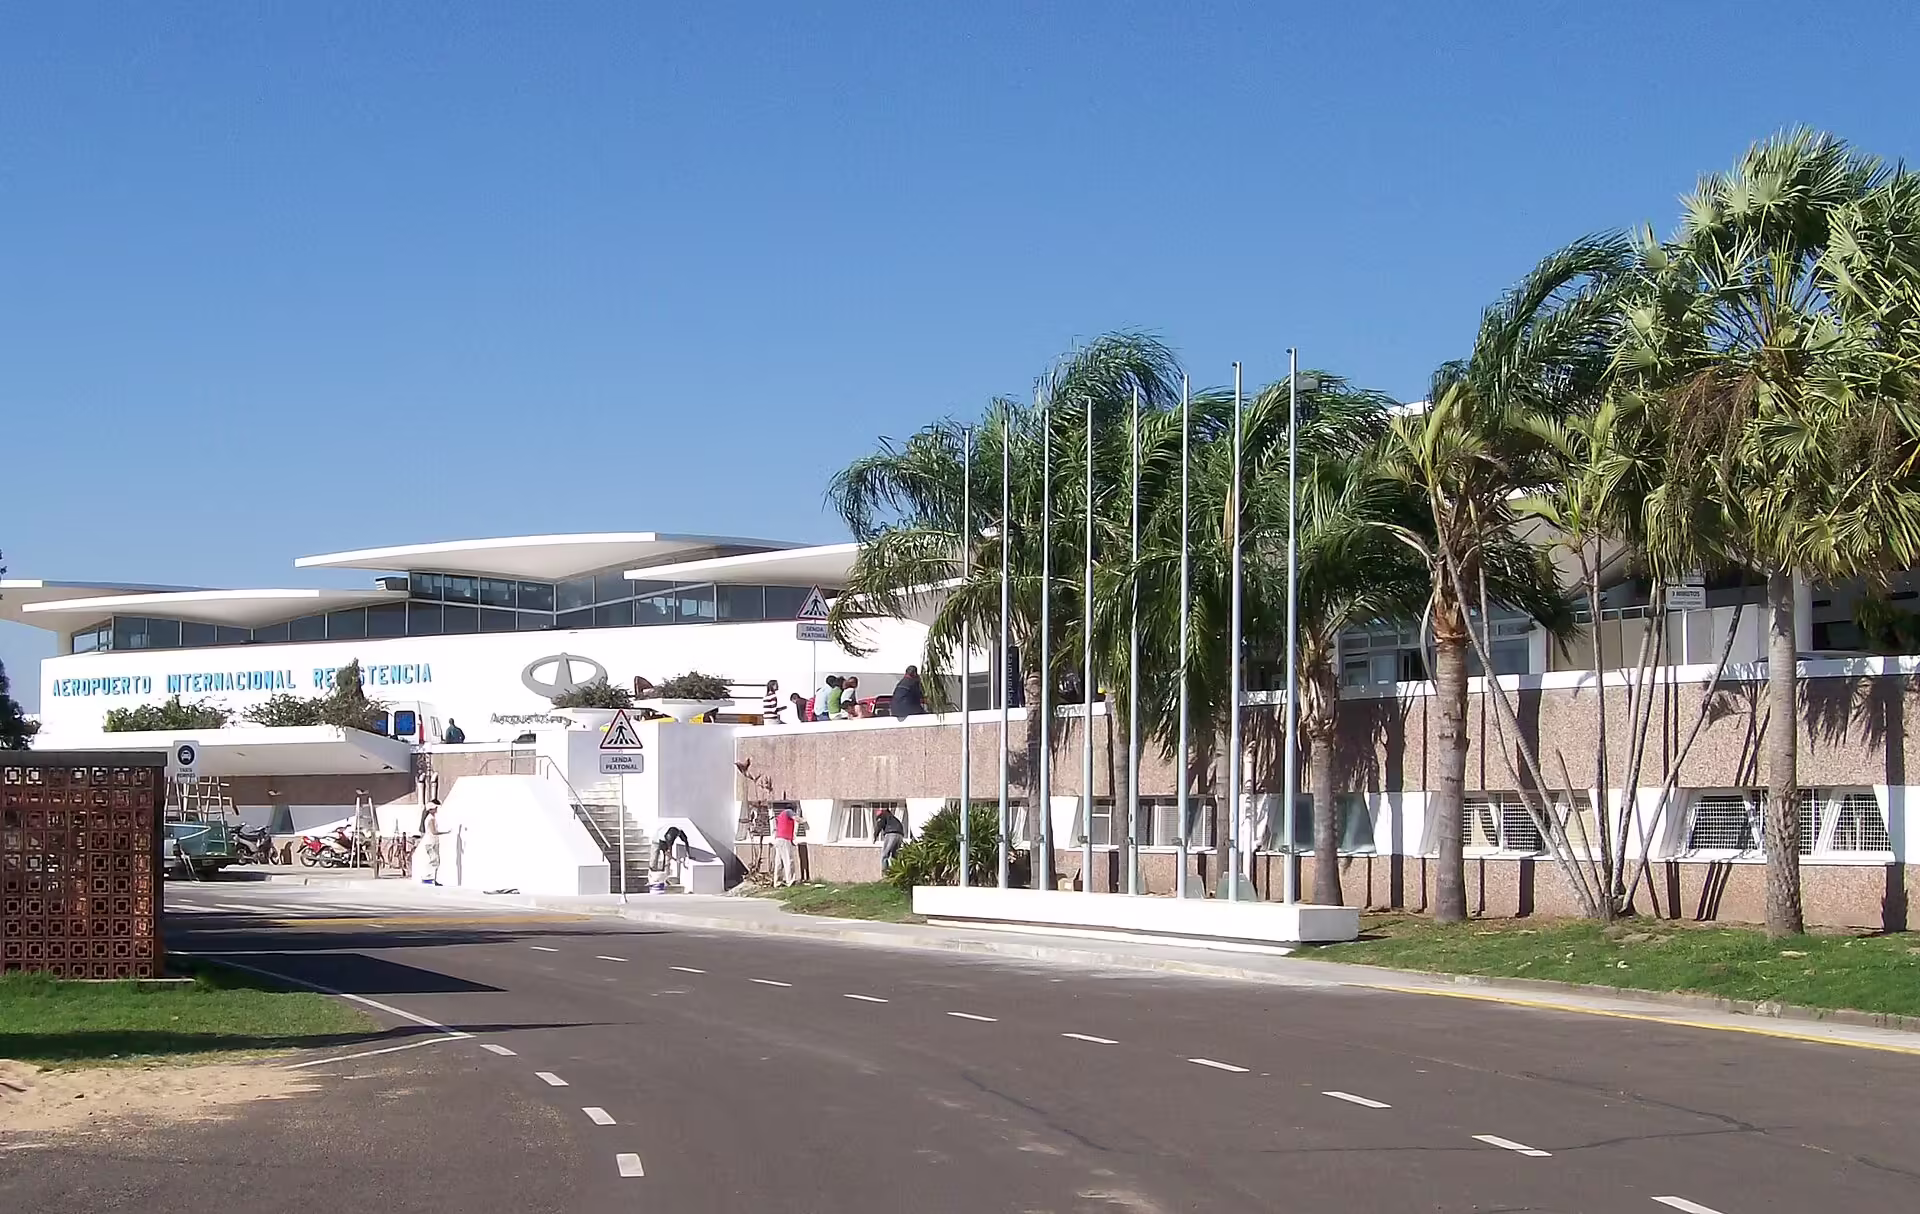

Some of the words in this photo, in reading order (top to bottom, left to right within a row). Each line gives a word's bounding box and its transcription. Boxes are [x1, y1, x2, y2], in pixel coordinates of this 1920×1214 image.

[53, 675, 152, 697] AEROPUERTO
[166, 669, 296, 694] INTERNACIONAL
[312, 662, 432, 690] RESTENCIA
